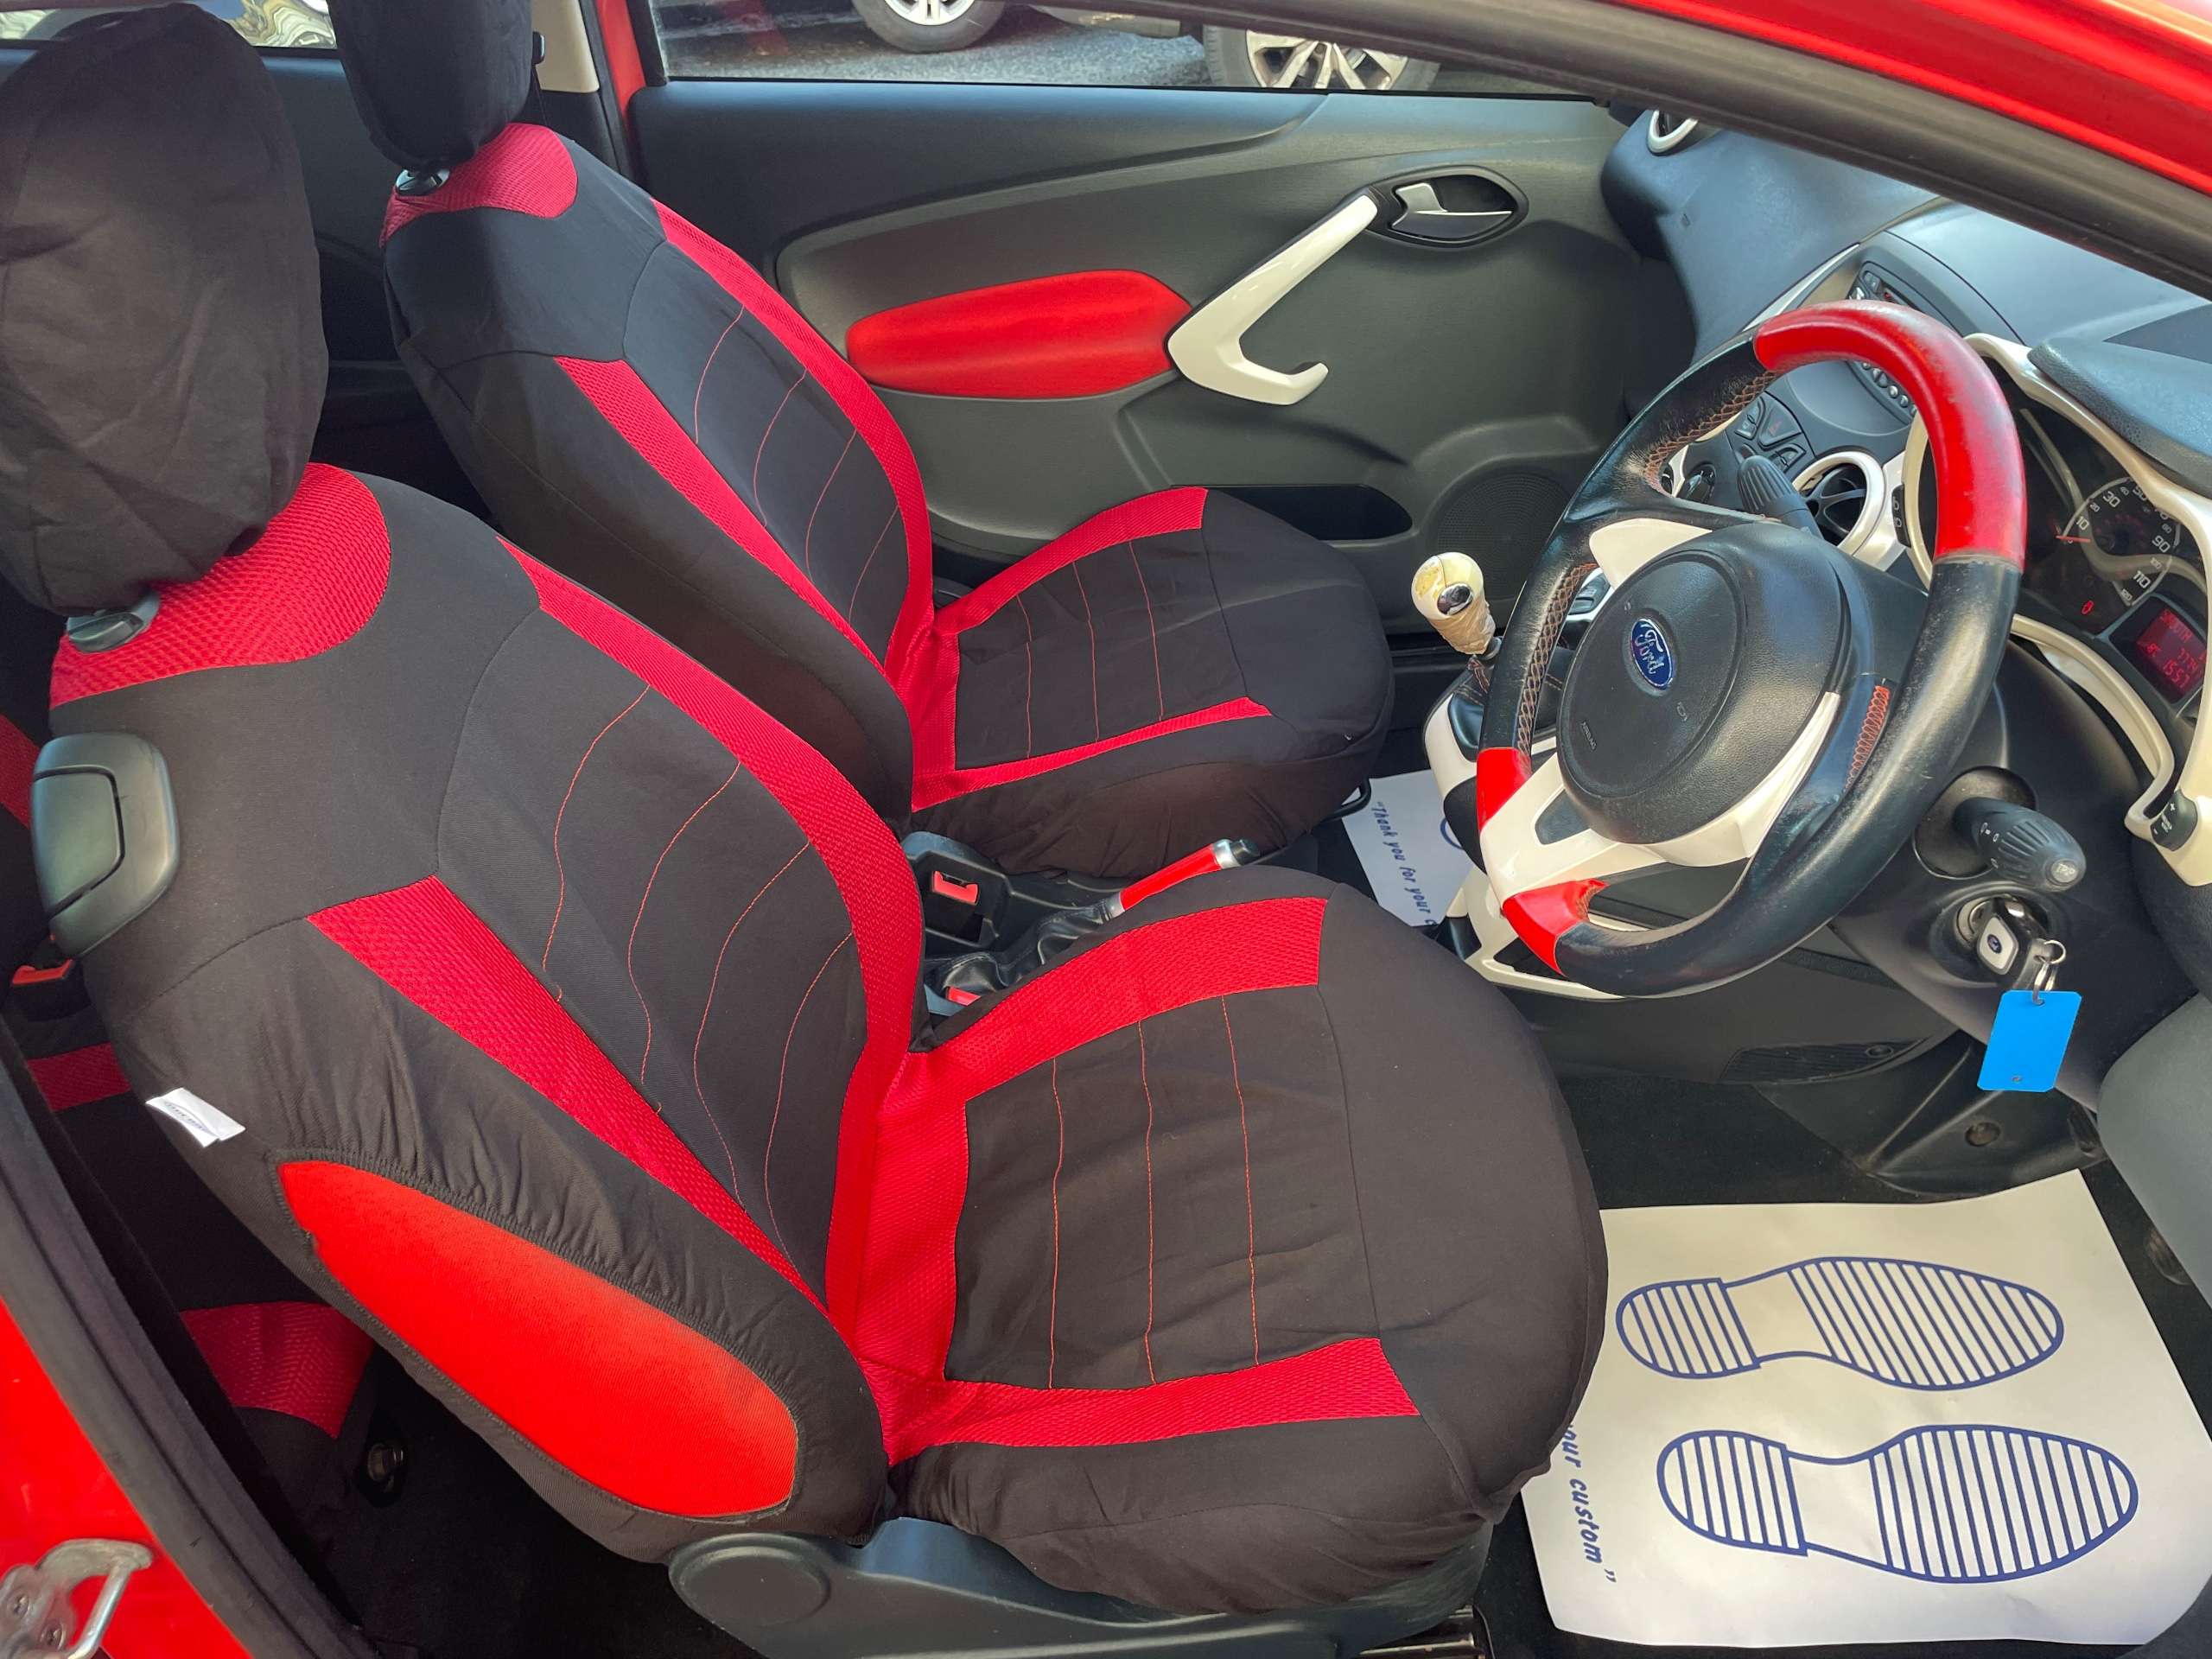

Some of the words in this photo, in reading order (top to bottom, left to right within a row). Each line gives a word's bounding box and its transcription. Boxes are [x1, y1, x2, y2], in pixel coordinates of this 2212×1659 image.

[2102, 490, 2120, 508] 30
[2075, 516, 2090, 531] 10
[2152, 535, 2171, 553] 90
[2133, 569, 2152, 588] 110
[1633, 622, 1667, 677] Ford
[1383, 840, 1406, 861] you
[1400, 866, 1416, 882] for
[1404, 887, 1431, 913] your
[1561, 1425, 1581, 1468] our
